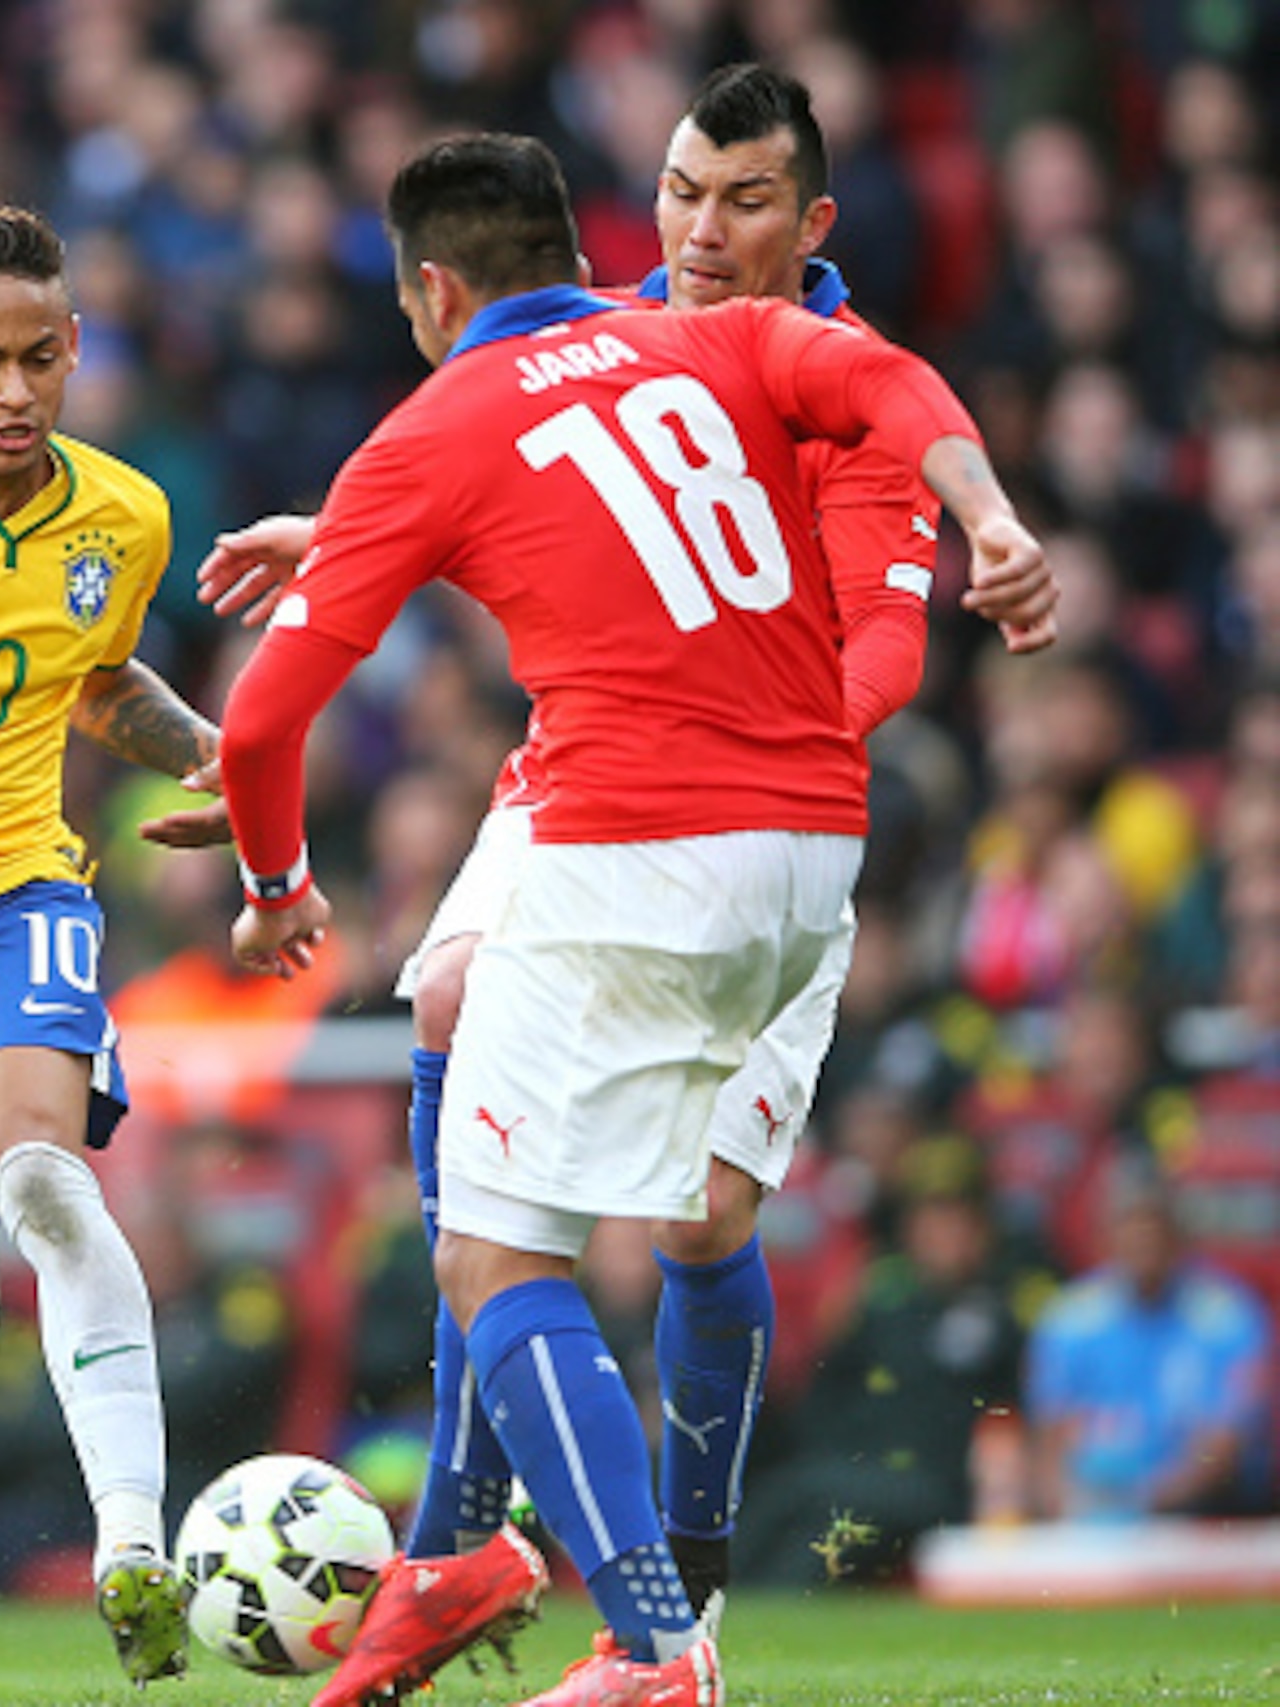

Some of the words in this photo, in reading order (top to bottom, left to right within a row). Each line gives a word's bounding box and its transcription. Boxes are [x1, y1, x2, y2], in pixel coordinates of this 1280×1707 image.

[515, 332, 639, 394] JARA
[515, 374, 792, 633] 18
[20, 912, 99, 993] 10
